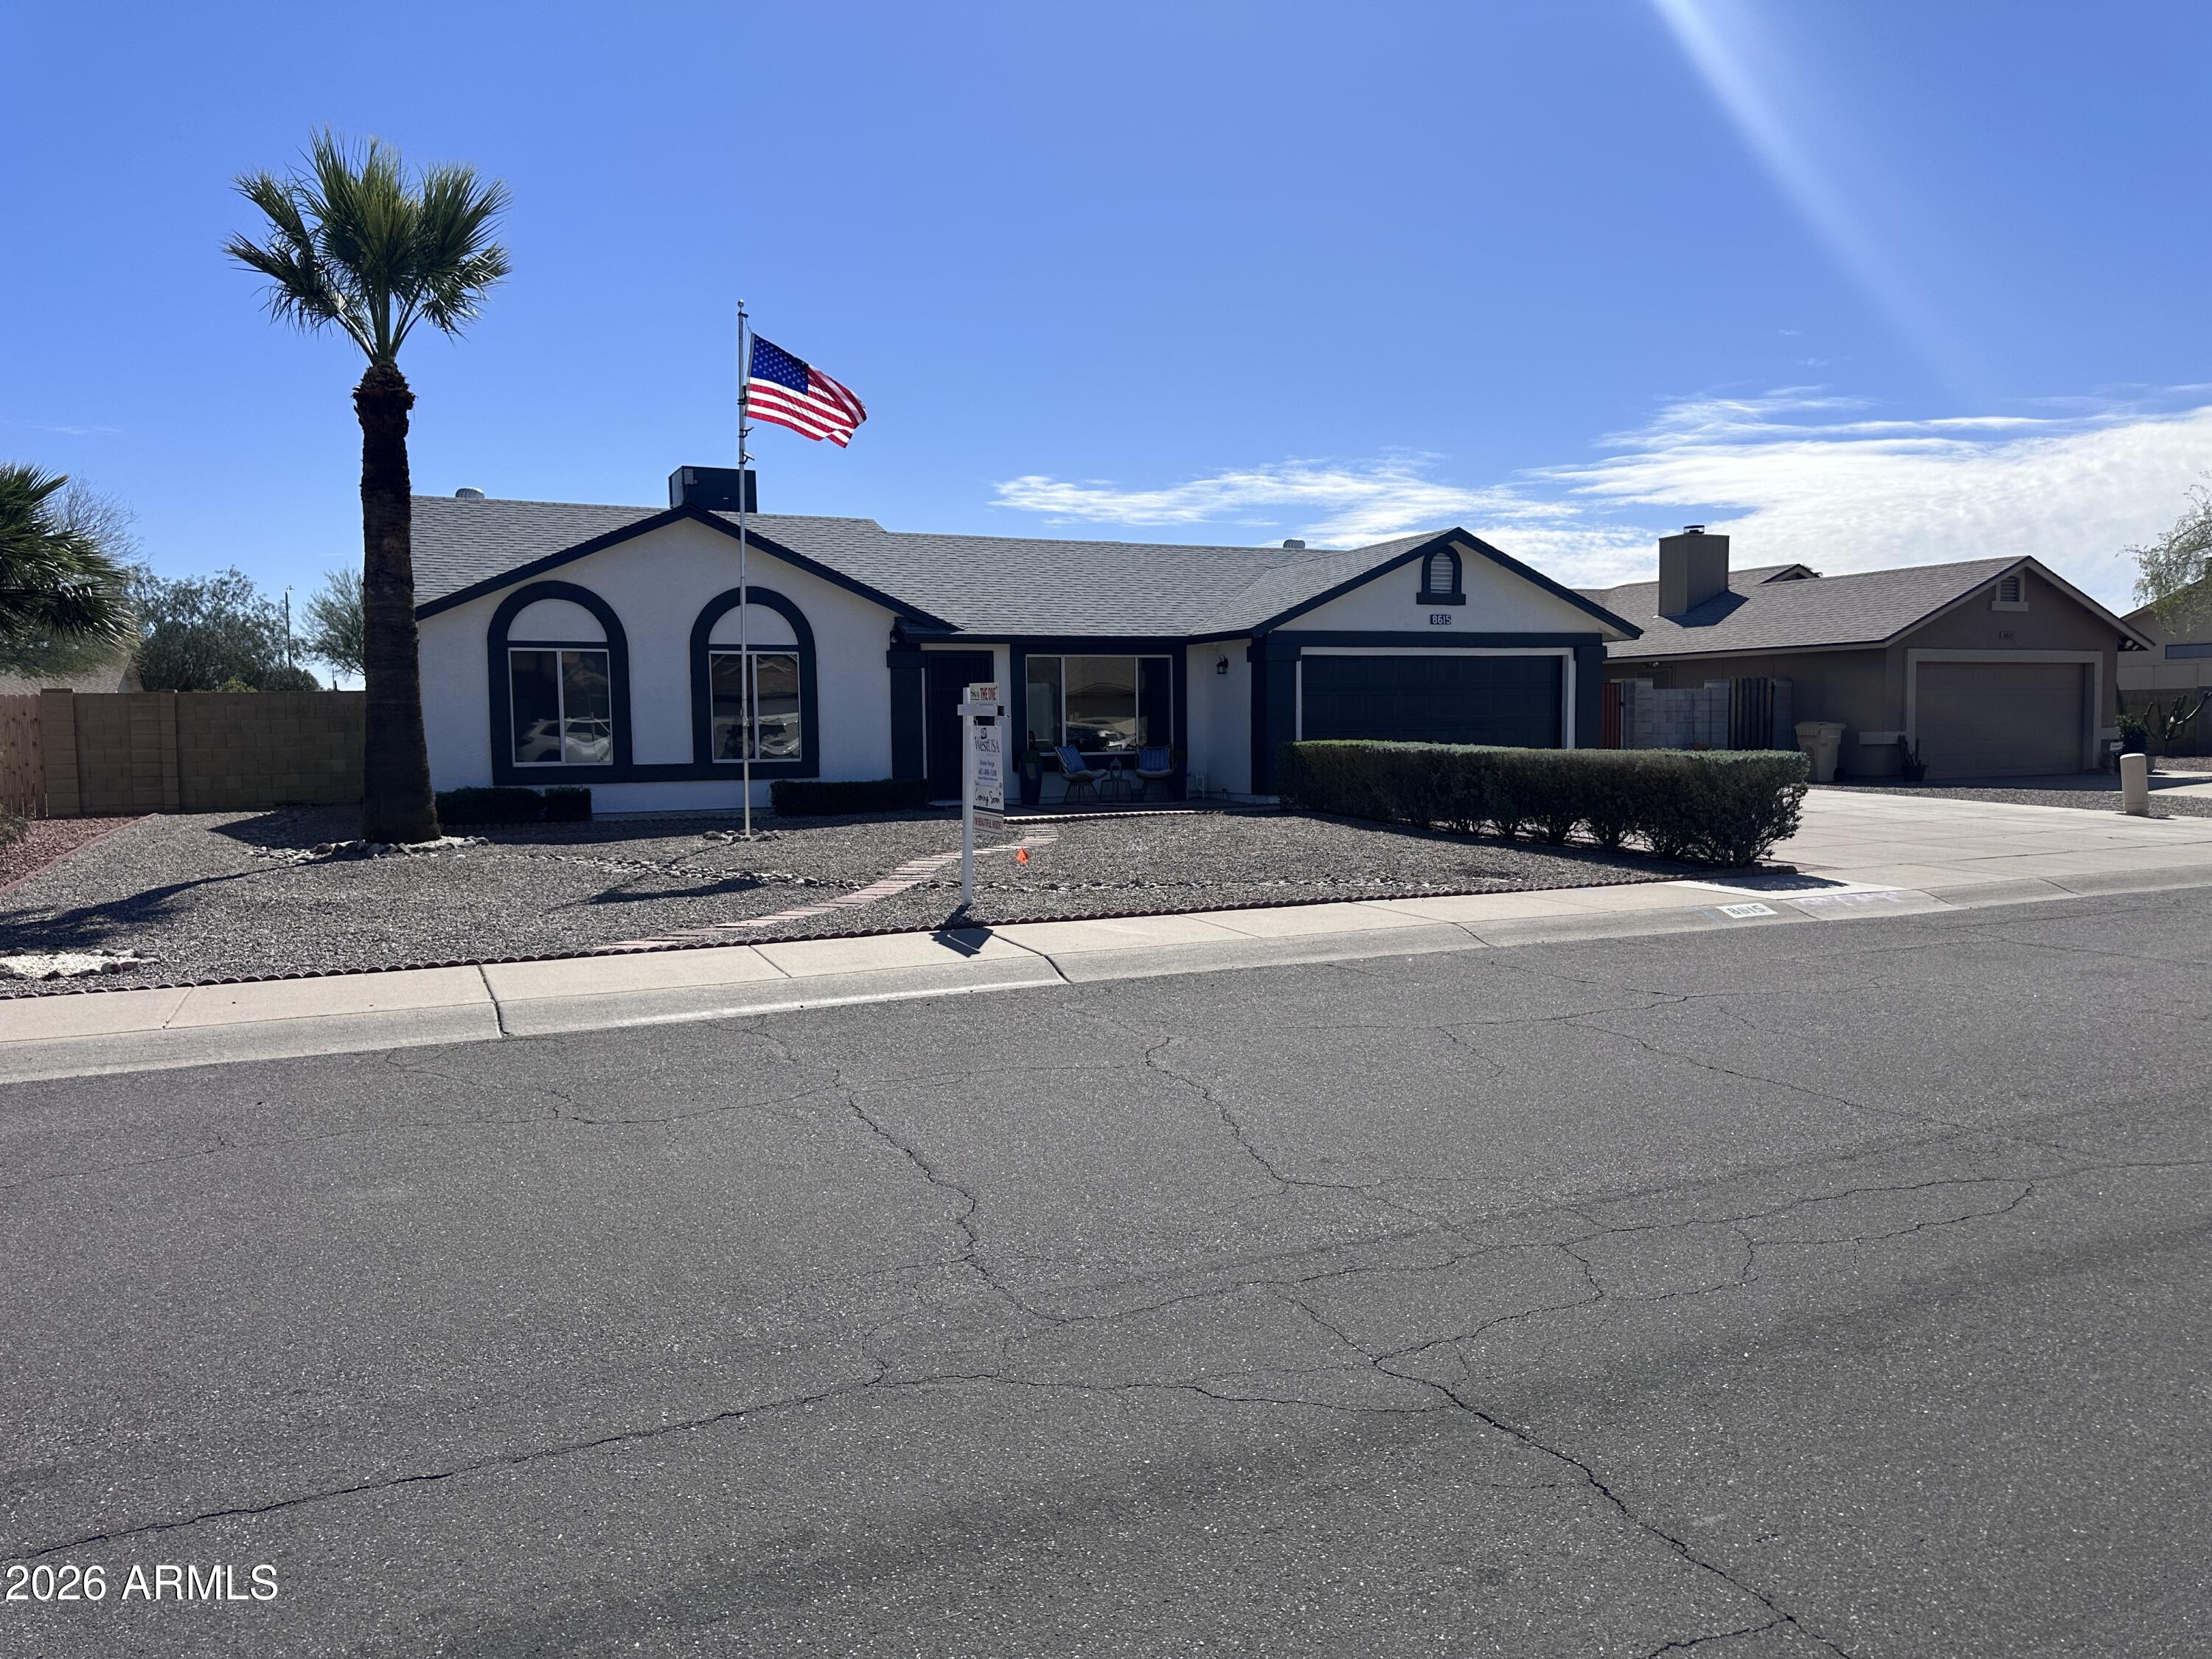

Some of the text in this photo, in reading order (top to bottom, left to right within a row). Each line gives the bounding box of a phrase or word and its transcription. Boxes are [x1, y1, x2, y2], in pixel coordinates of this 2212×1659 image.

[1432, 615, 1451, 625] 8615
[988, 687, 996, 700] ONE
[1727, 905, 1766, 915] 8615
